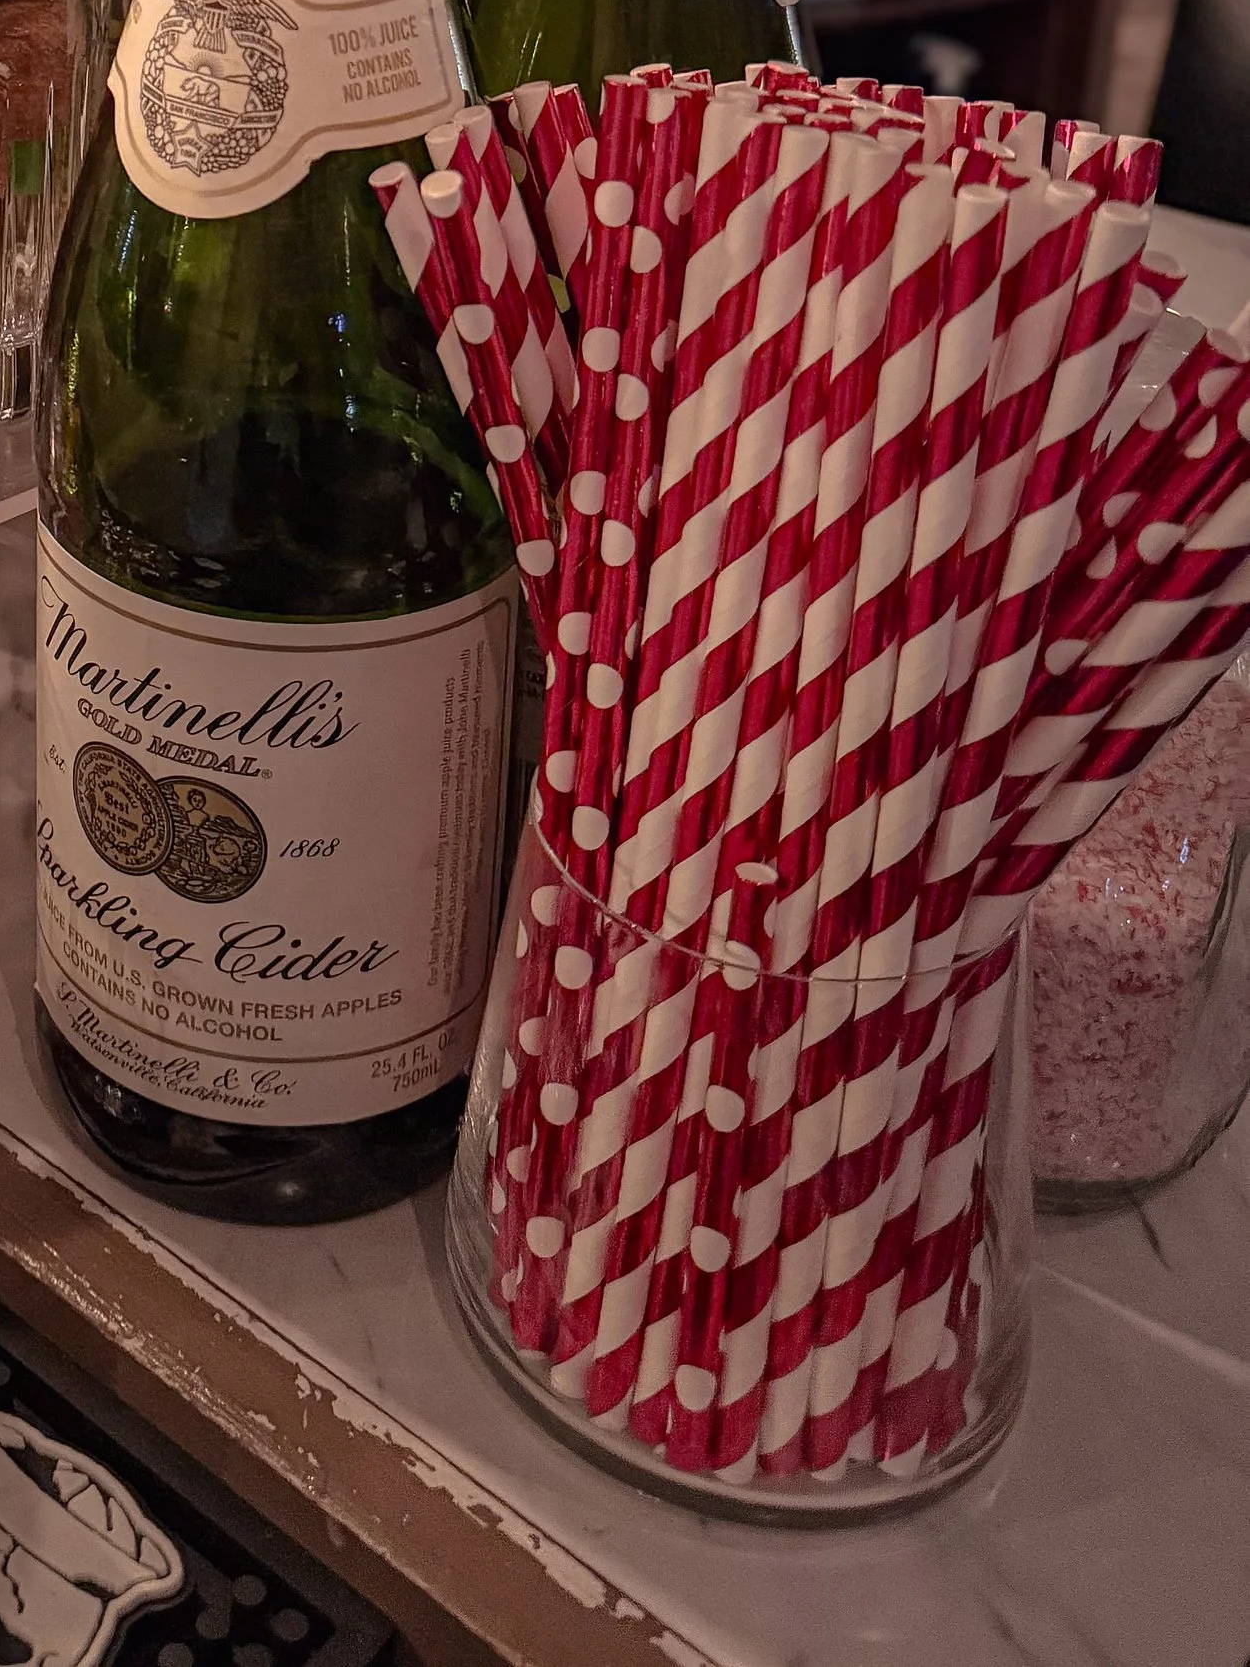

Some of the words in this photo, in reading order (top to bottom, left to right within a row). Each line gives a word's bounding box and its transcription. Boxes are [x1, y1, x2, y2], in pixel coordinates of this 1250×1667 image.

[328, 26, 377, 55] 100%
[379, 15, 419, 46] JUICE
[346, 48, 413, 79] CONTAINS
[342, 82, 363, 104] NO
[366, 69, 422, 99] ALCOHOL
[40, 575, 361, 751] Martinelli's
[77, 697, 143, 745] GOLD
[278, 836, 341, 860] 1868
[37, 816, 203, 969] Sparkling
[214, 921, 400, 983] Cider
[63, 941, 137, 1005] CONTAINS
[142, 997, 170, 1021] NO
[176, 1011, 283, 1042] ALCOHOL
[68, 923, 108, 969] FROM
[113, 960, 146, 991] U.S.
[152, 980, 234, 1017] GROWN
[241, 1002, 315, 1021] FRESH
[321, 987, 402, 1018] APPLES
[76, 1000, 201, 1083] Martinelli
[213, 1067, 241, 1091] &
[371, 1052, 407, 1079] 25.4
[166, 1074, 269, 1109] California
